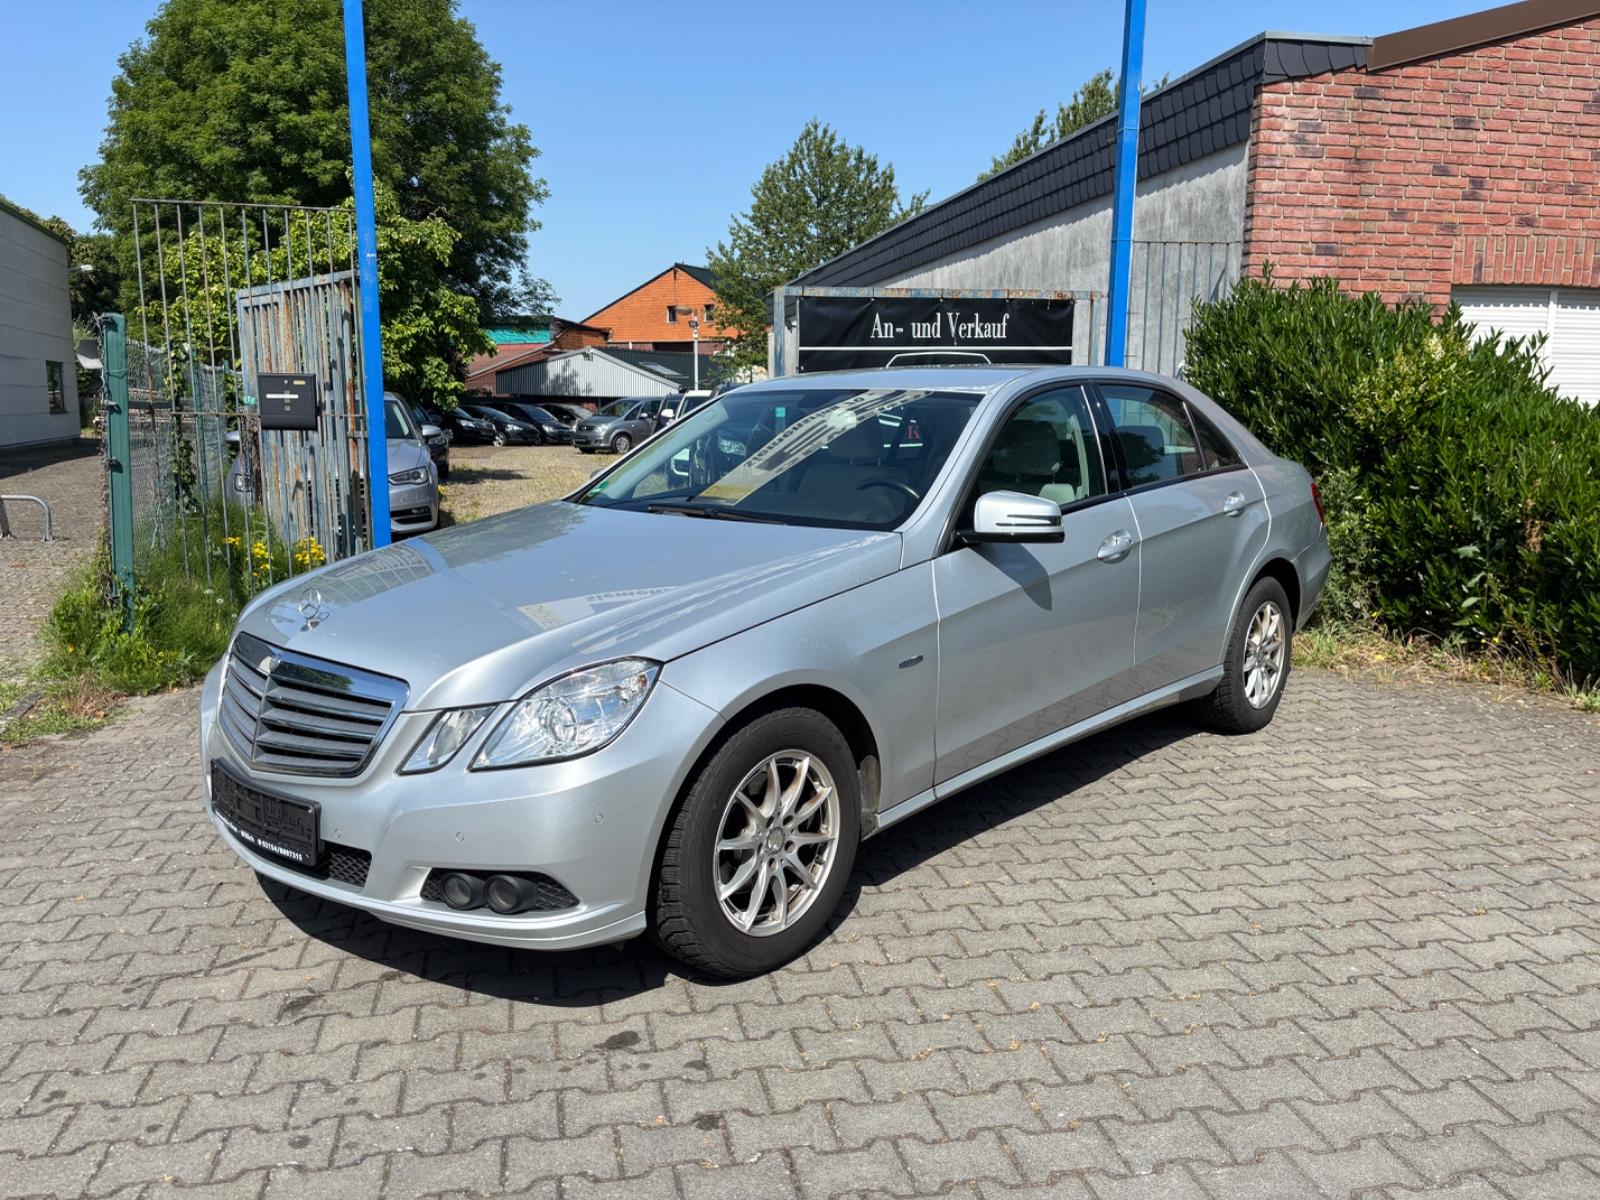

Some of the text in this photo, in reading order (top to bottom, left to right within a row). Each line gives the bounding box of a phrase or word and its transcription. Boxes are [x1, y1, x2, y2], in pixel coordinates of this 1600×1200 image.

[870, 312, 1010, 339] An- und Verkauf
